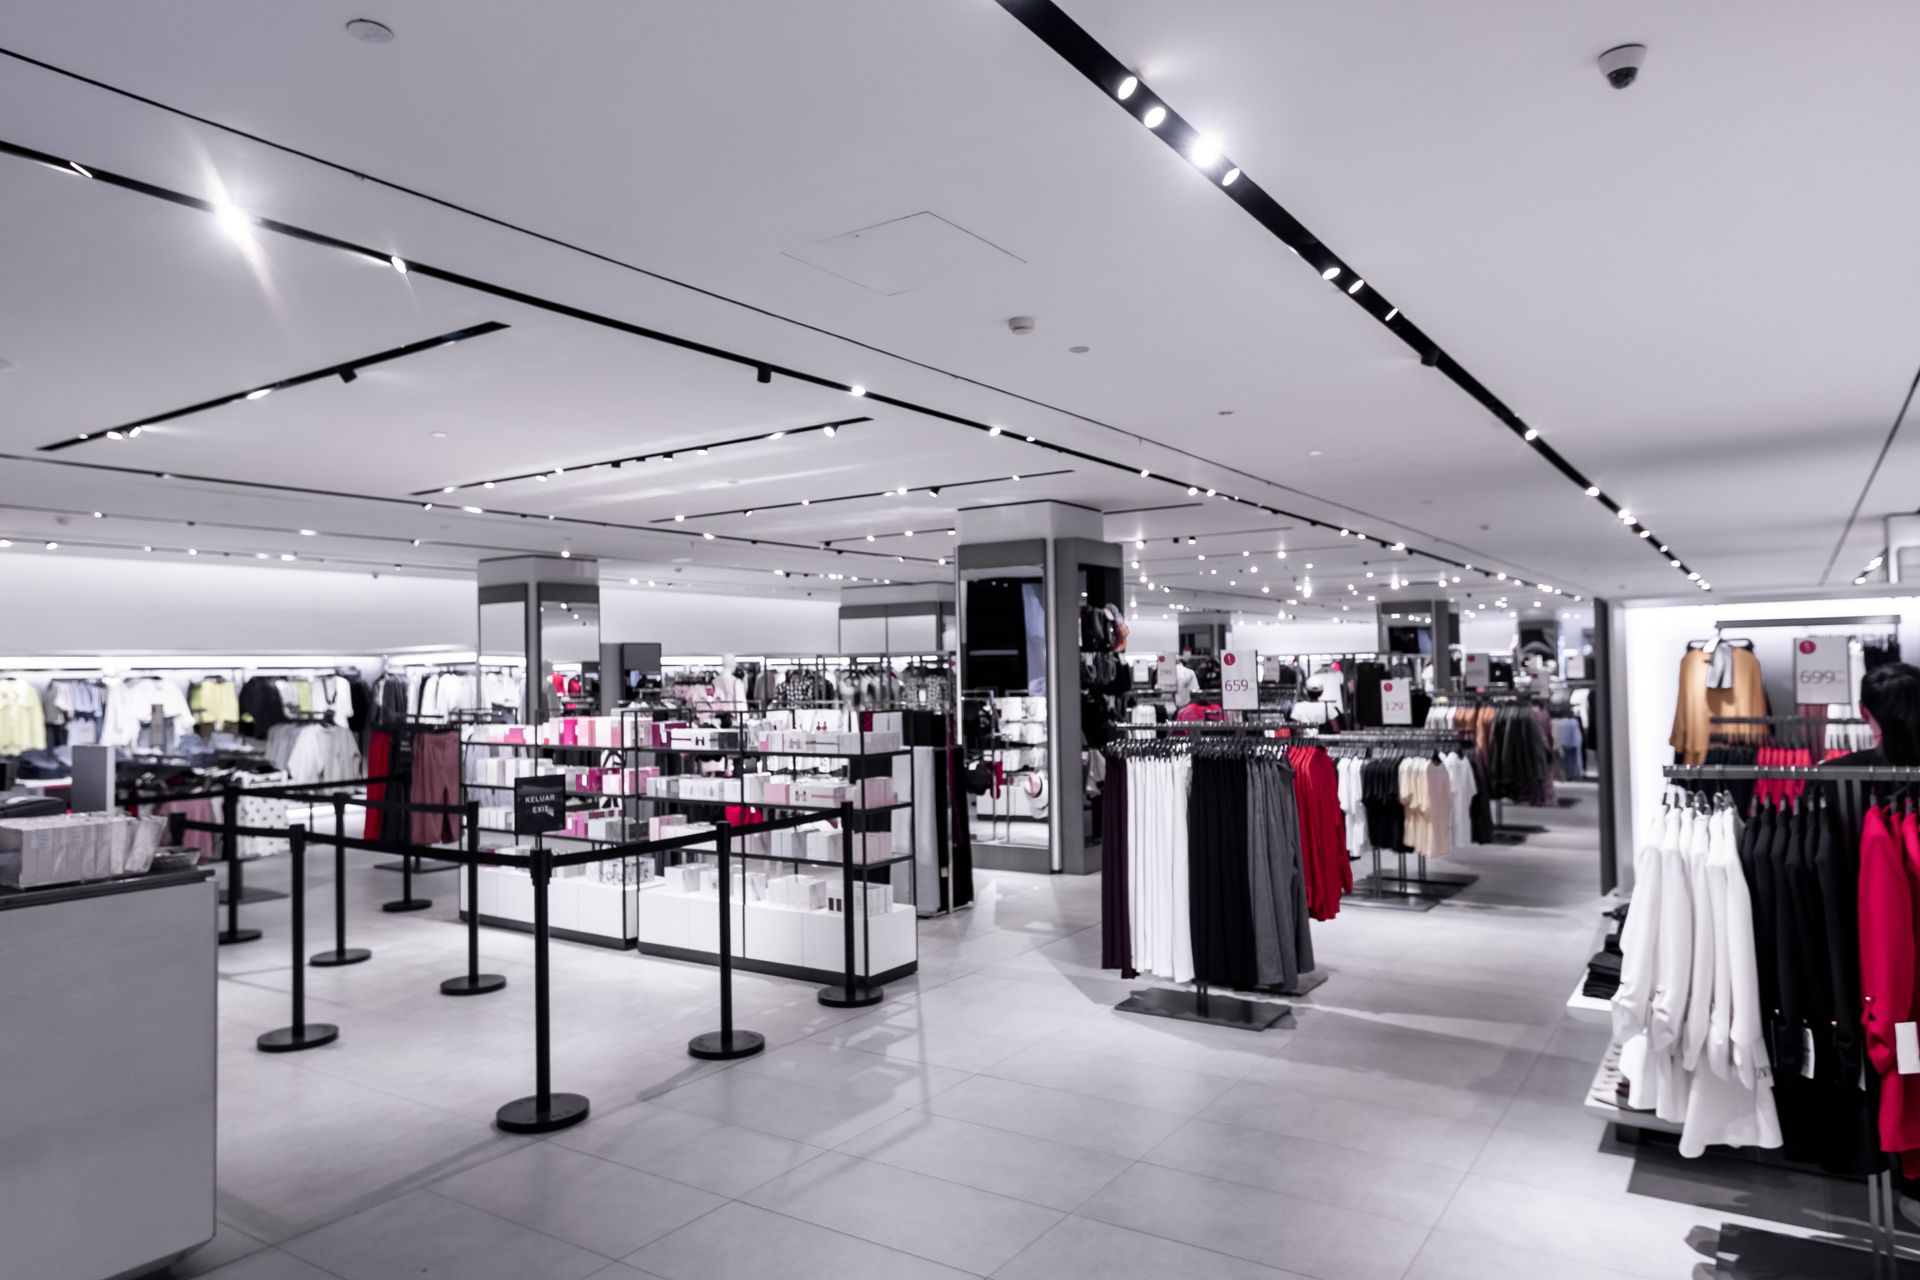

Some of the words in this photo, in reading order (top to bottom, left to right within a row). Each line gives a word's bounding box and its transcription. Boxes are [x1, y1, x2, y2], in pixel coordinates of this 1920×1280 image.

[1799, 669, 1836, 685] 699
[525, 794, 556, 803] KELUAR
[532, 805, 549, 814] EXIT
